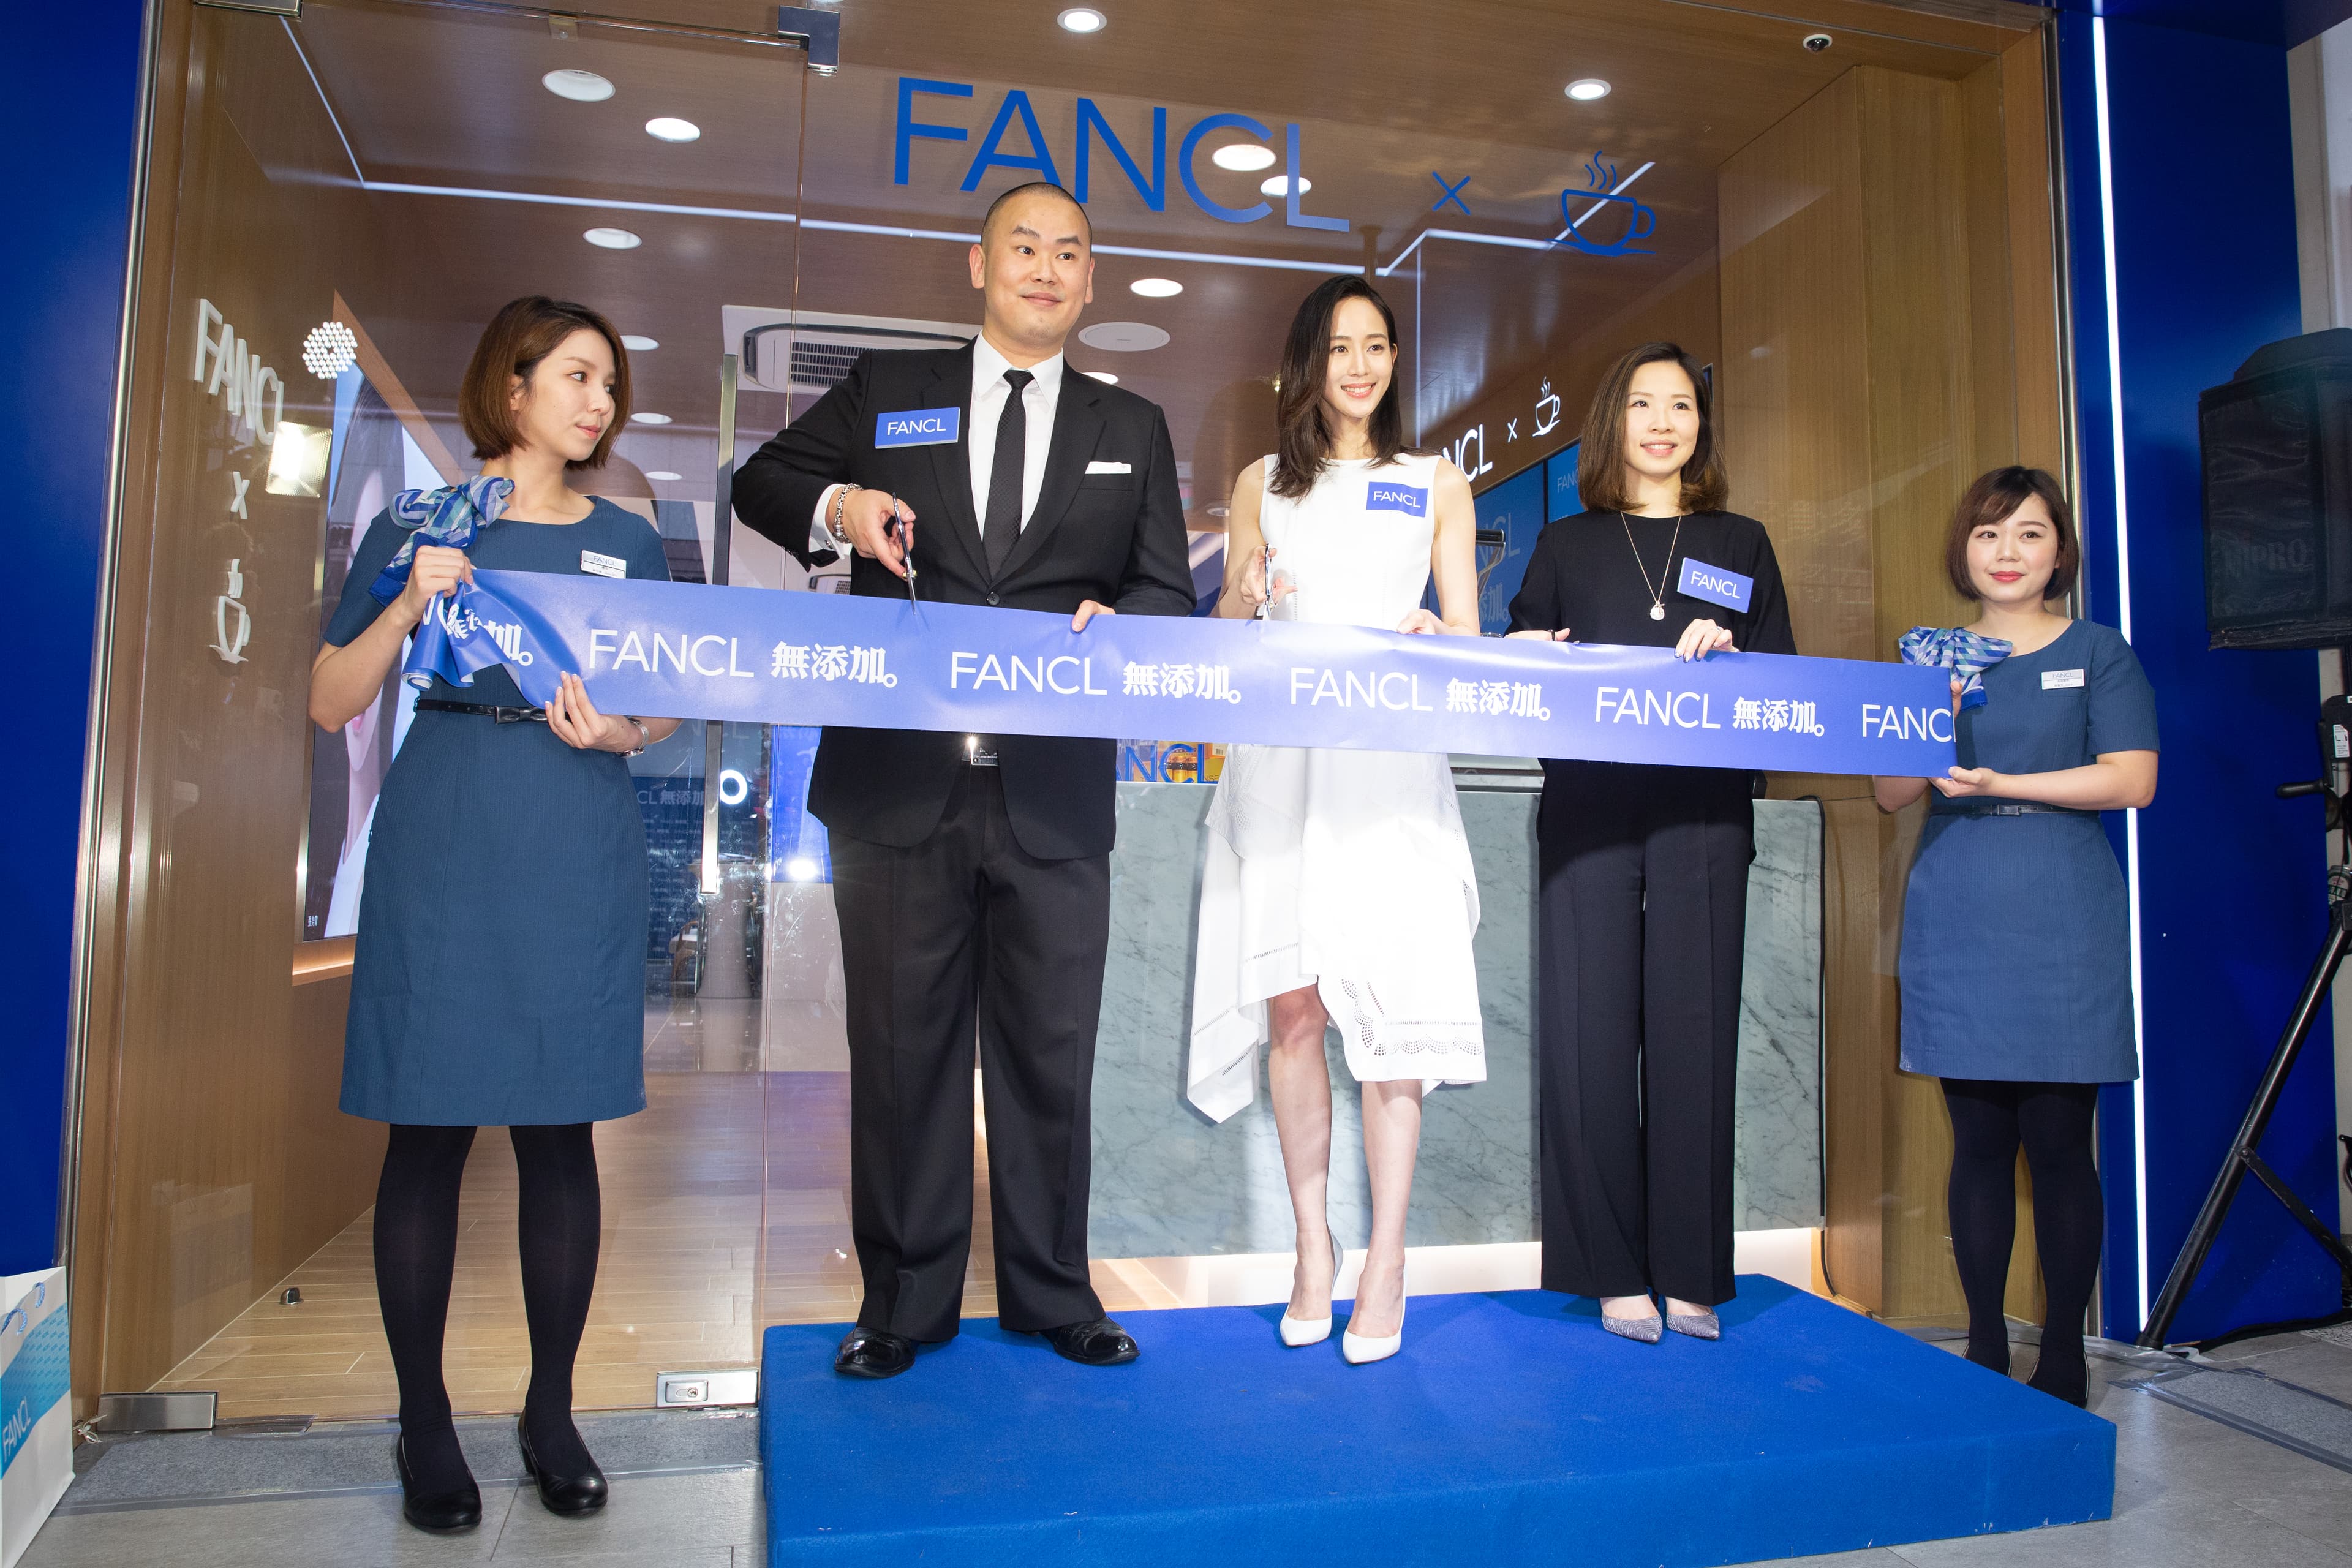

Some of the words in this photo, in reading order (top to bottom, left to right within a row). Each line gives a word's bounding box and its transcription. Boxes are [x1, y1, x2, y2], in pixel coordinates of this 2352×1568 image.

[894, 77, 1349, 232] FANCL
[887, 418, 946, 435] FANCL
[1373, 491, 1421, 508] FANCL
[594, 556, 616, 566] FANCL
[1691, 570, 1740, 599] FANCL
[589, 629, 754, 677] FANCL
[771, 640, 897, 688] 無添加。
[951, 652, 1107, 696] FANCL
[1123, 662, 1242, 704] 無添加。
[1291, 667, 1433, 712] FANCL
[1446, 677, 1551, 722] 無添加。
[1595, 687, 1721, 729] FANCL
[1732, 696, 1825, 737] 無添加。
[1862, 704, 1956, 743] FANC
[1116, 743, 1219, 784] NCL
[2, 1396, 31, 1463] FANCL
